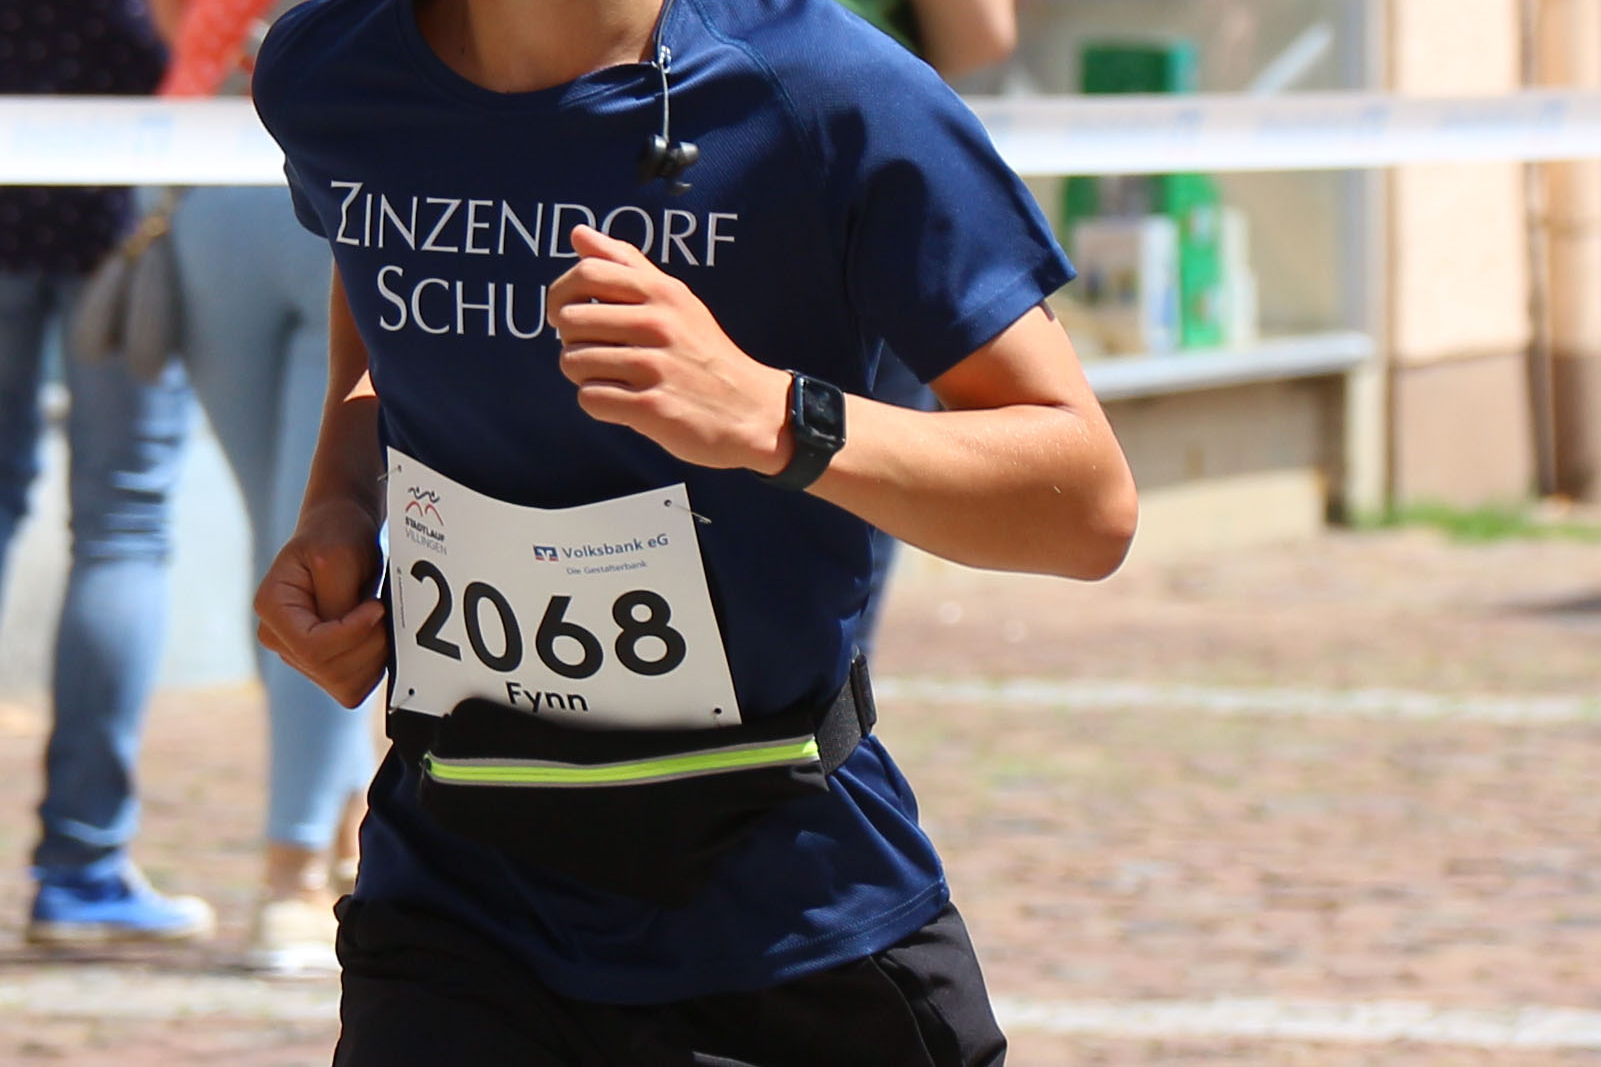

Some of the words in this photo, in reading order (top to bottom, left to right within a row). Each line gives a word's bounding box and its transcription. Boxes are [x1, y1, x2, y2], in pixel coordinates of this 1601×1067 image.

[330, 180, 738, 267] ZINZENDORF
[376, 265, 562, 340] SCHU
[405, 527, 448, 555] VILLINGEN
[561, 538, 644, 559] Volksbank
[647, 533, 669, 548] eG
[583, 560, 647, 574] Gestalterbank
[410, 559, 687, 680] 2068
[505, 681, 589, 712] Fynn
